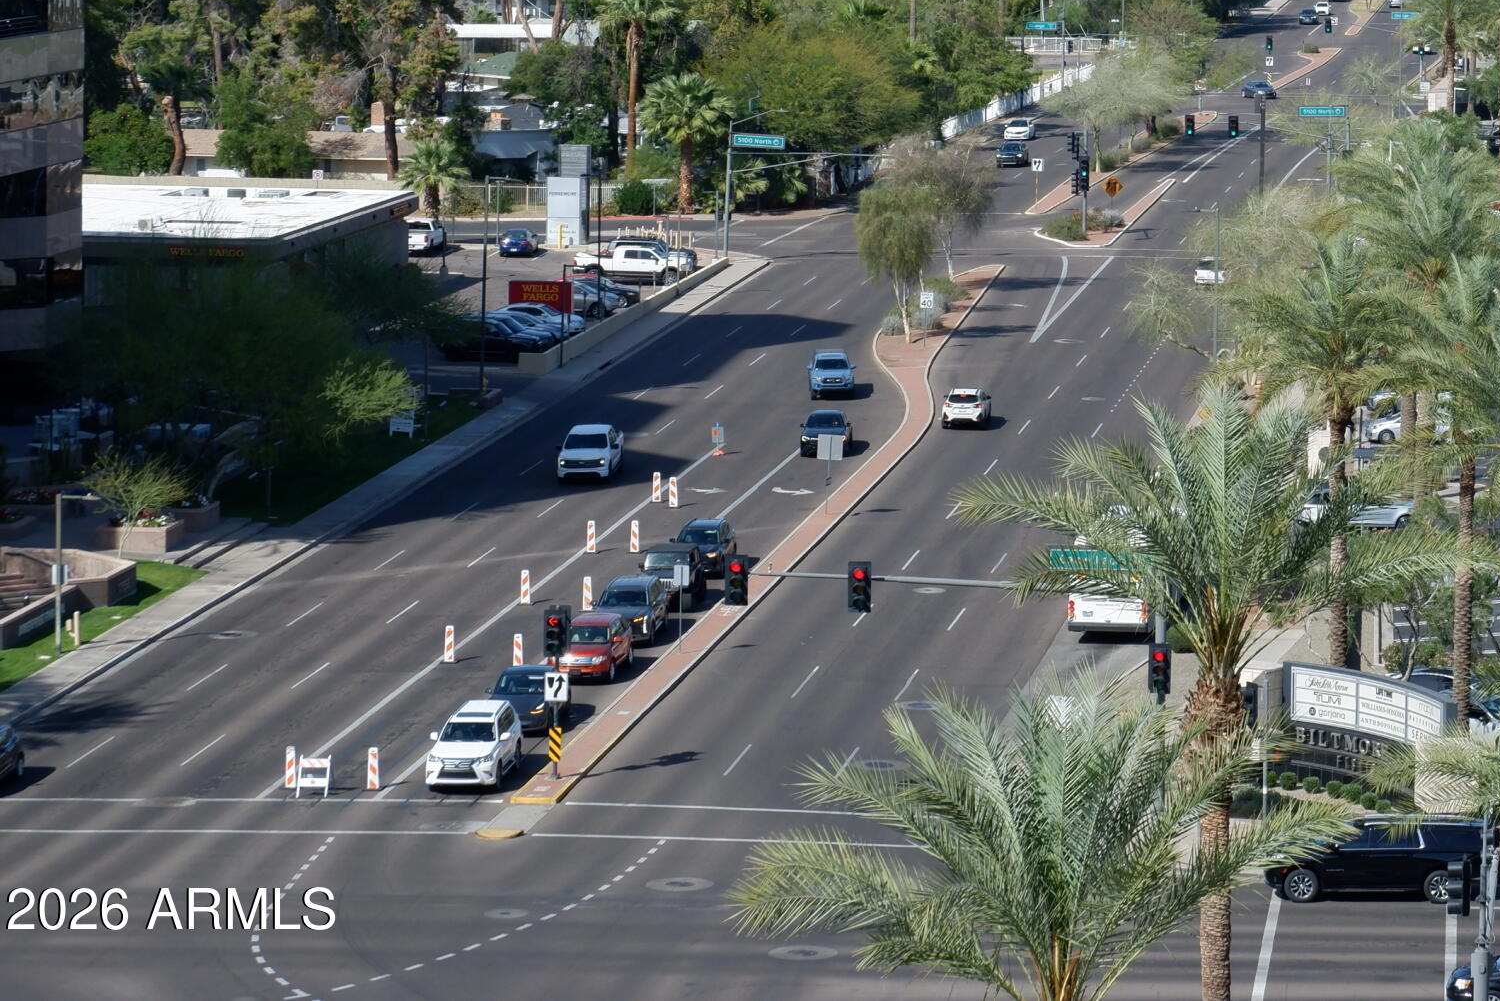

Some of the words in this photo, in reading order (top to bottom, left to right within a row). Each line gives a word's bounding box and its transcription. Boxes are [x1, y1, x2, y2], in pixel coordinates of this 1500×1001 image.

[522, 284, 559, 293] WELLS
[522, 293, 559, 302] FARGO
[921, 299, 932, 308] 40
[1313, 691, 1342, 706] TUMI
[1318, 709, 1346, 720] gorjana
